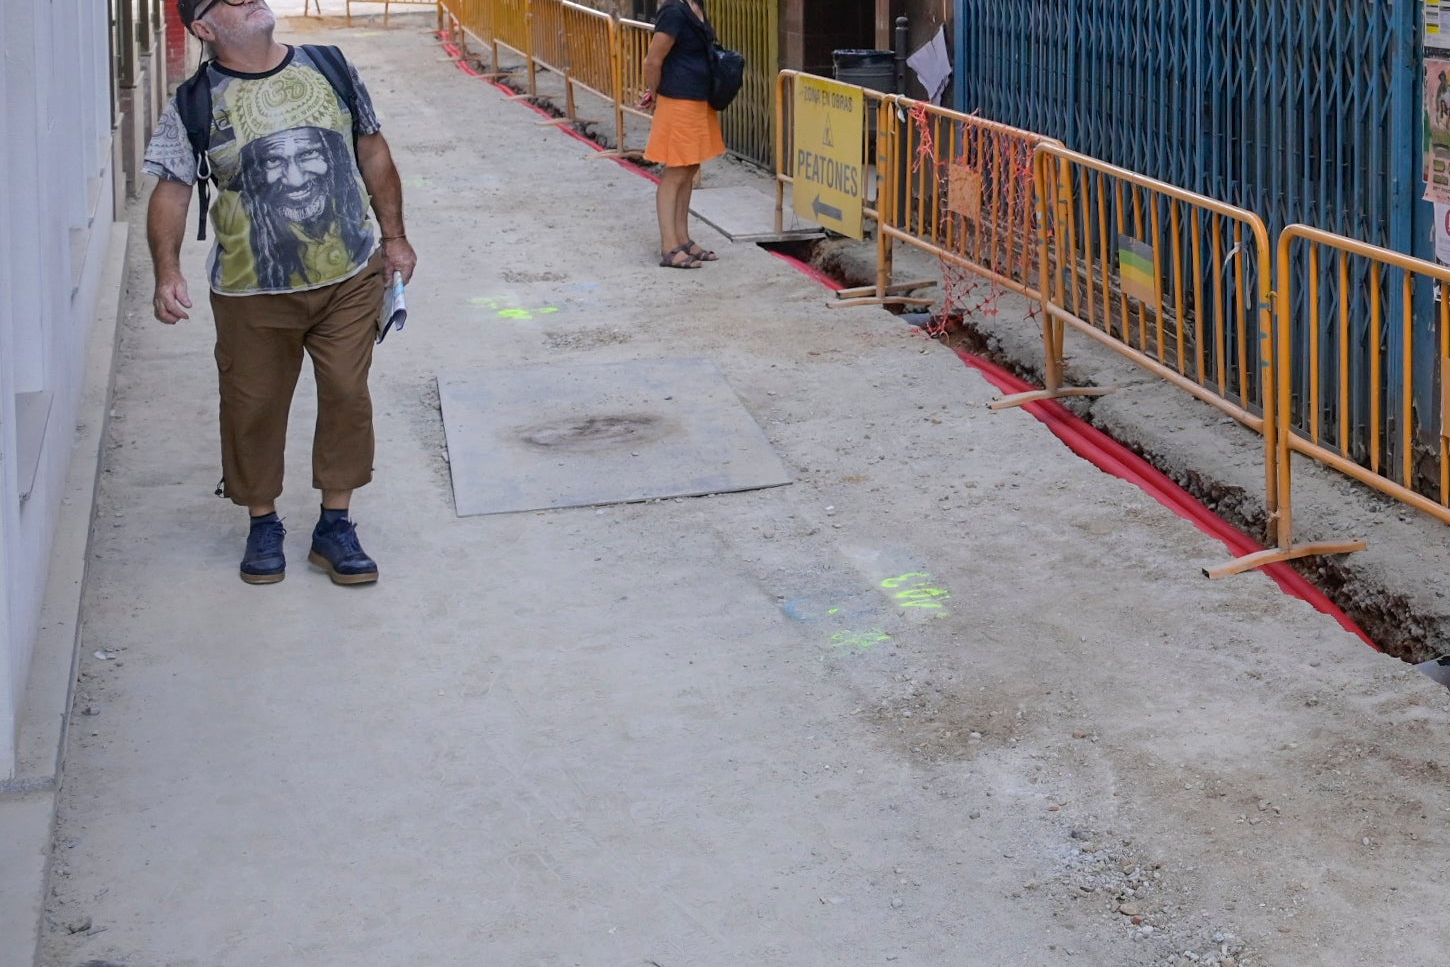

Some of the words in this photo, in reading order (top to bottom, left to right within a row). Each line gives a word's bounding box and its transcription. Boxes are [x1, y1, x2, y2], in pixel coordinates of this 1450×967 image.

[803, 86, 820, 103] ZONA
[822, 89, 831, 106] EN
[832, 92, 853, 113] OBRAS
[797, 148, 858, 198] PEATONES
